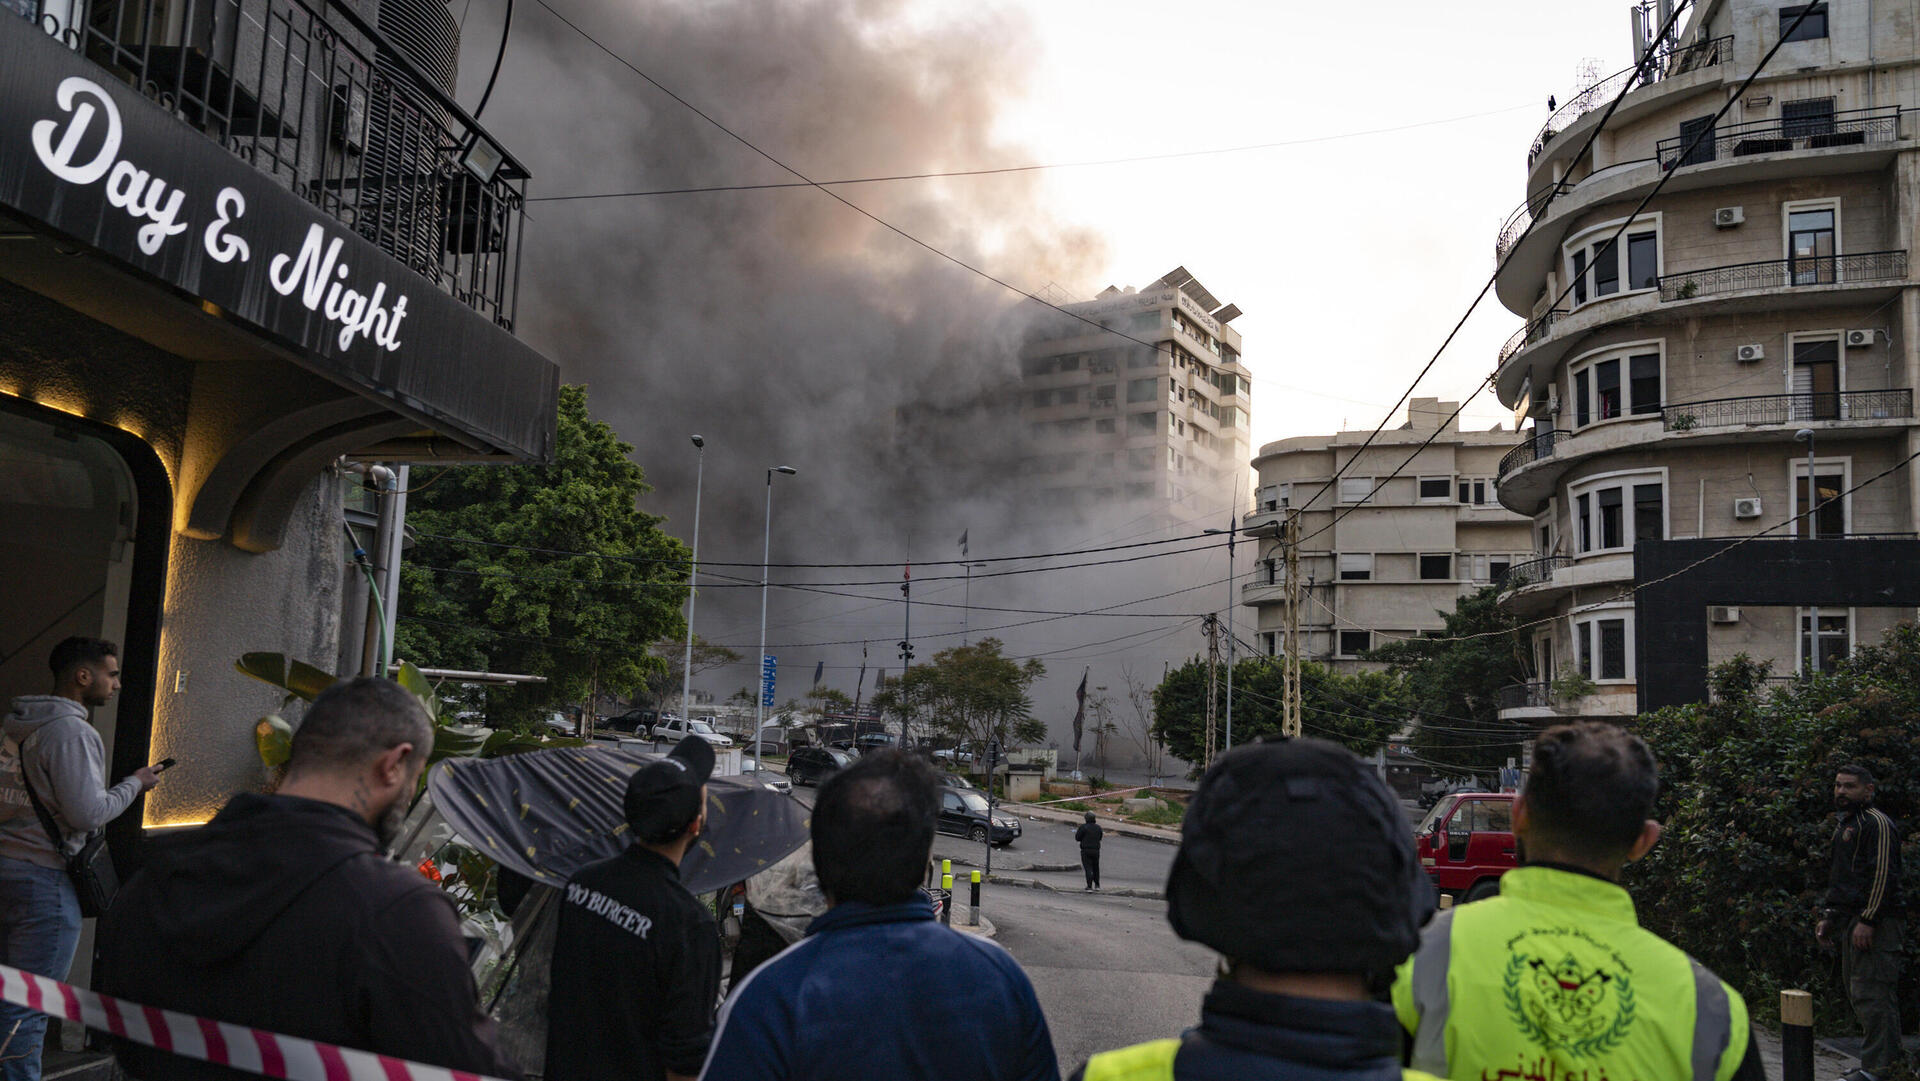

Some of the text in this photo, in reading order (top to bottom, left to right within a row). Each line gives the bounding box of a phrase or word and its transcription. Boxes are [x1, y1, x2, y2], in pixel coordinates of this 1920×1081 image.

[31, 76, 408, 352] Day & Night
[586, 890, 653, 940] BURGER
